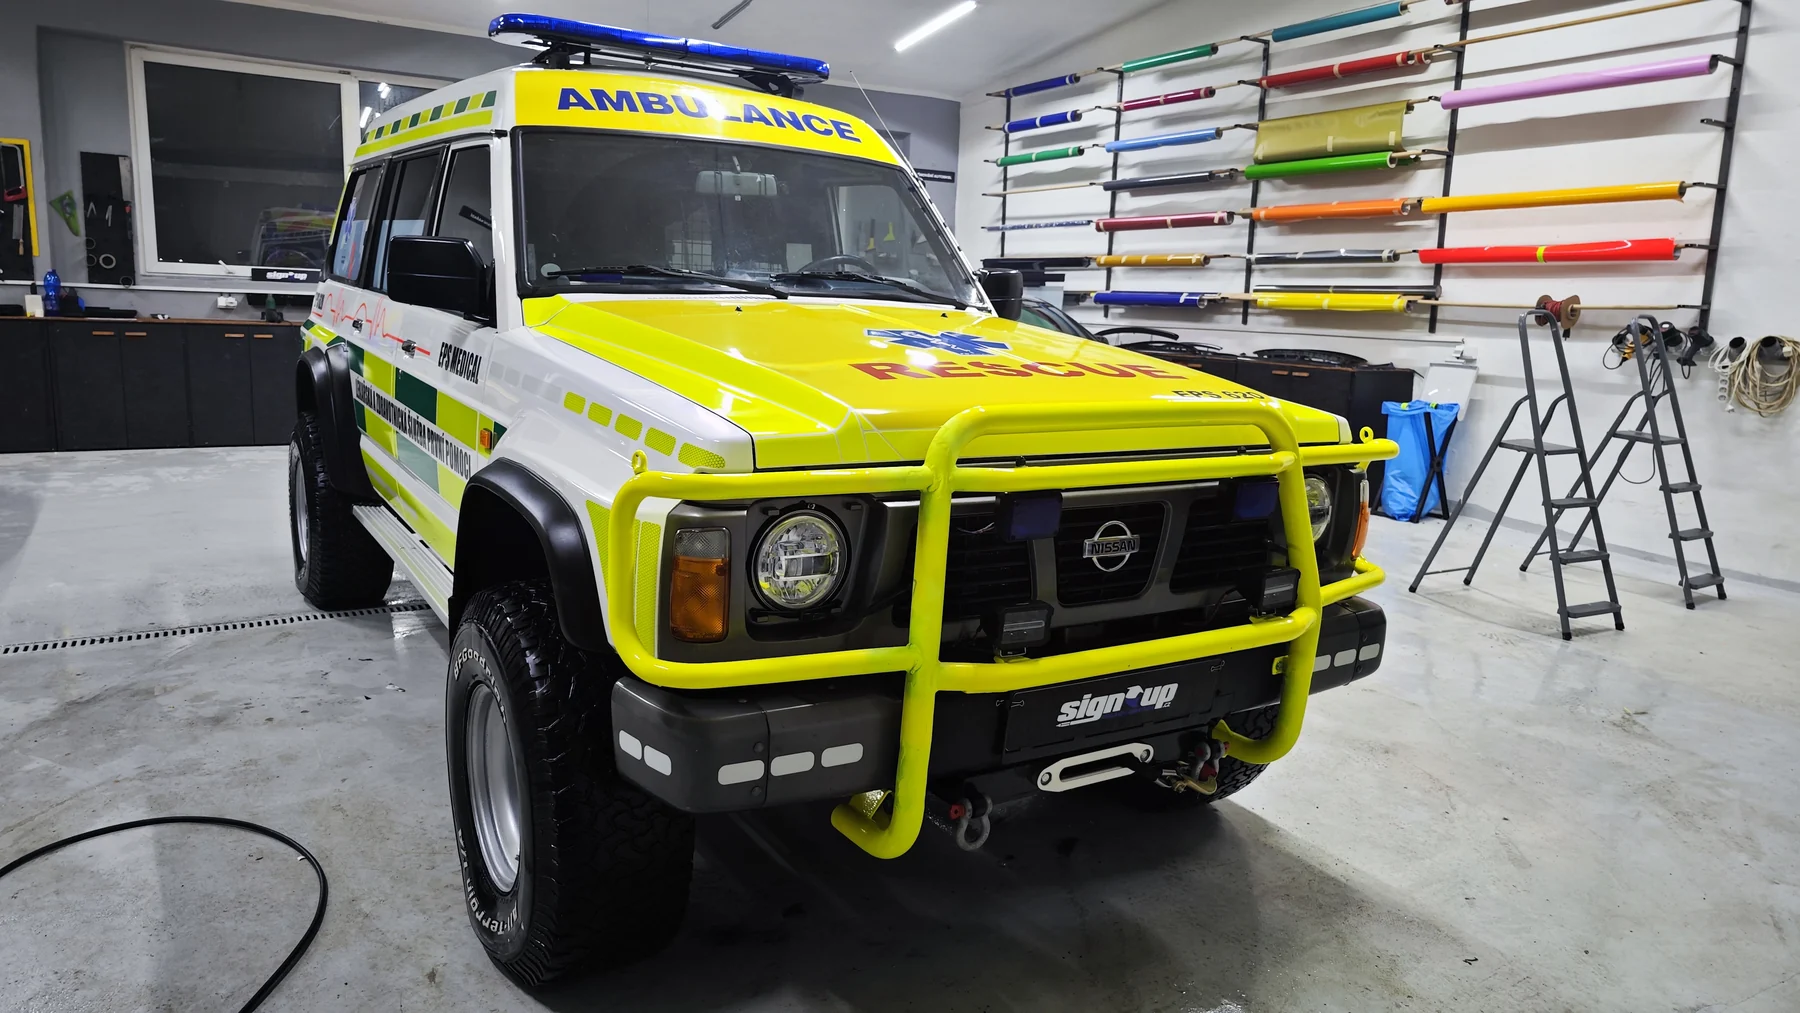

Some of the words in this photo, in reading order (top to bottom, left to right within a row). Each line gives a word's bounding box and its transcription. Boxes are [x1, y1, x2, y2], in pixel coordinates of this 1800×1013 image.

[438, 341, 453, 371] EPS
[449, 346, 482, 385] MEDICAL
[847, 361, 1189, 381] RESCUE
[1171, 390, 1222, 399] EPS
[1221, 390, 1265, 399] 620
[427, 426, 445, 463] PRVNÍ
[445, 439, 471, 480] POMOCI
[1090, 539, 1138, 556] NISSAN
